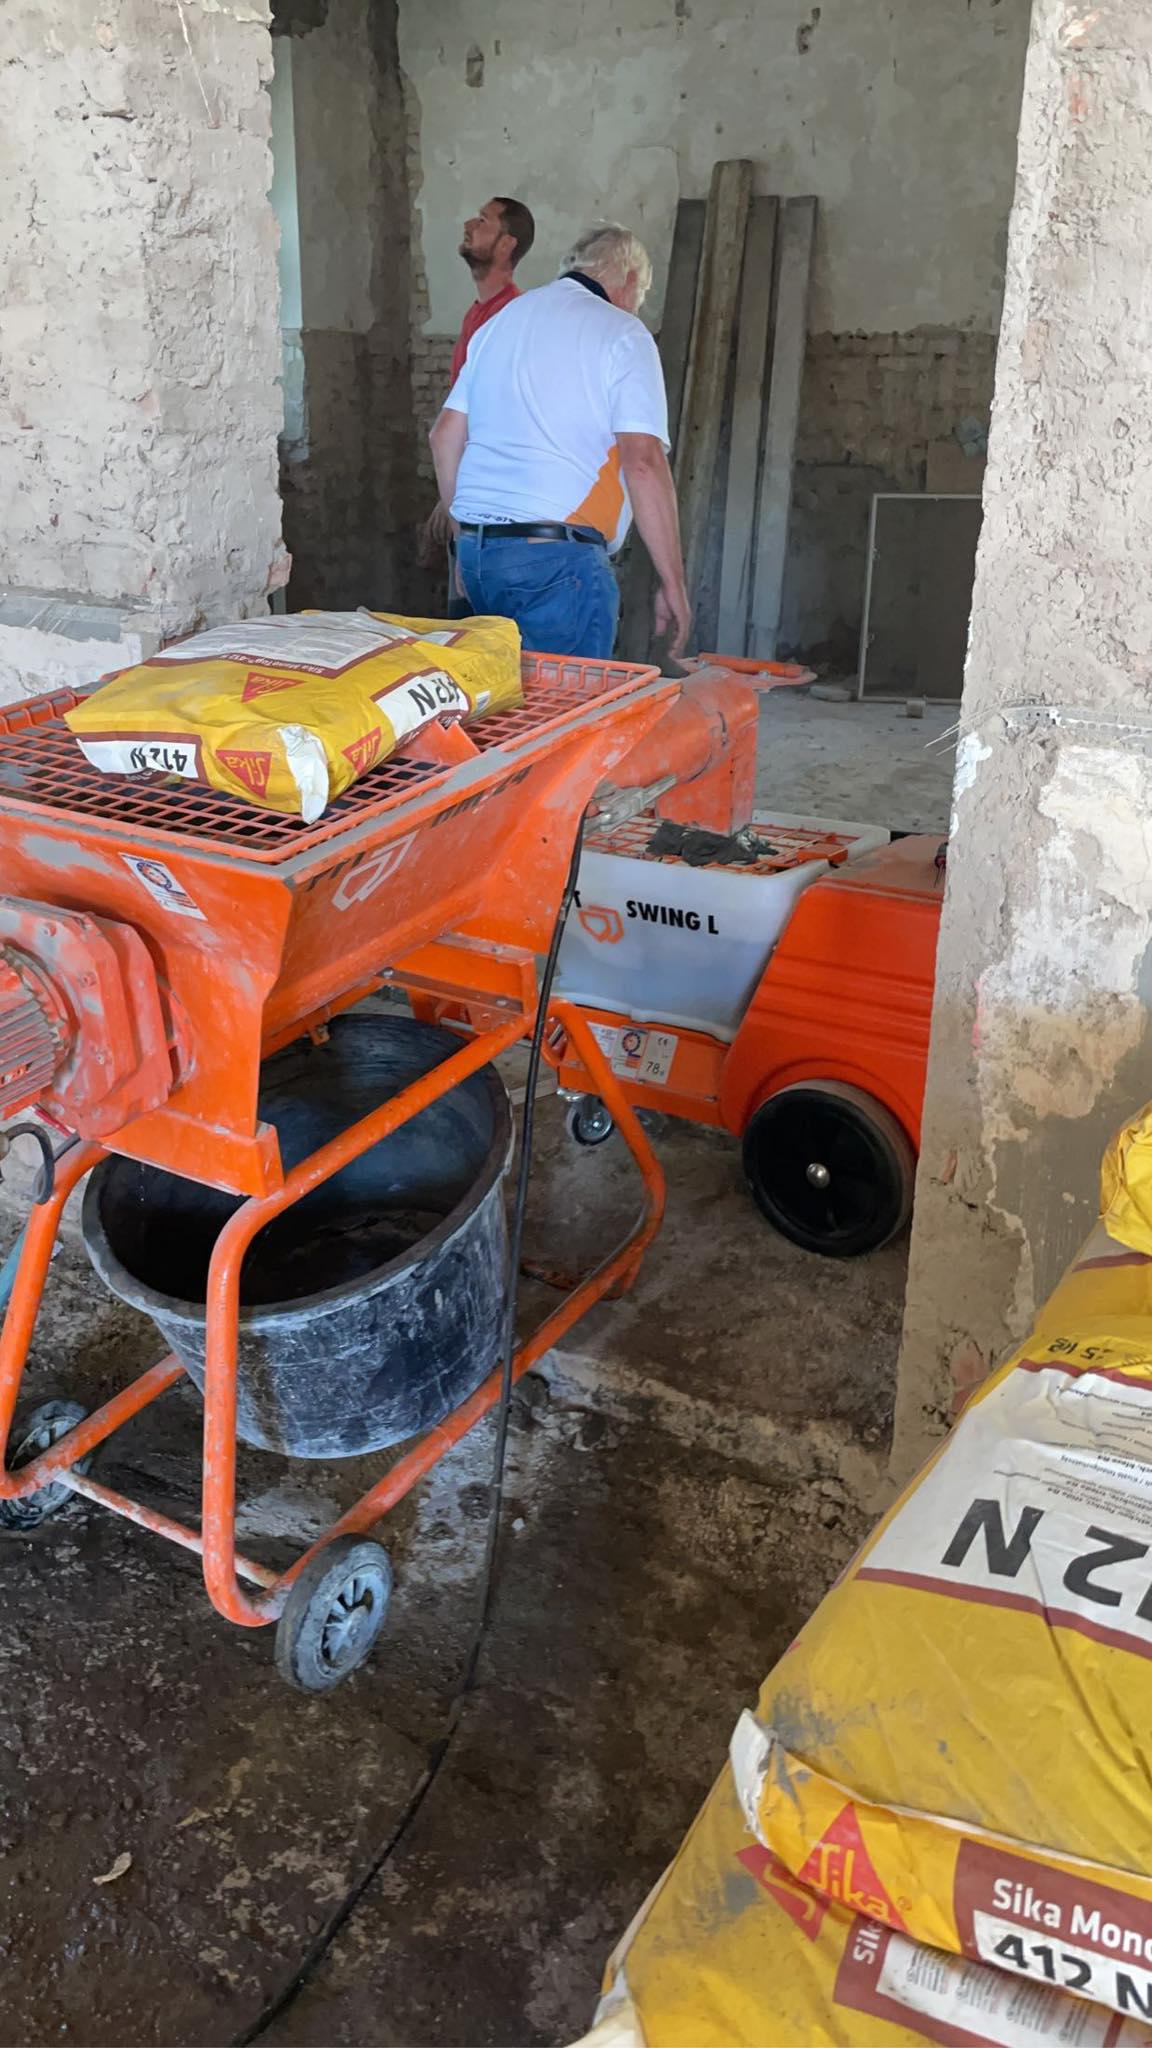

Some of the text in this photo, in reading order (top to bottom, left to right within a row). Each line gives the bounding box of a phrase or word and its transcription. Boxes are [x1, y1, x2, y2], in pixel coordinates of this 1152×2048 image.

[407, 682, 437, 717] N
[130, 747, 188, 772] 412 N
[225, 756, 266, 786] Sika
[626, 900, 719, 935] SWING L
[646, 1061, 660, 1074] 78
[940, 1498, 1152, 1622] 2 N
[808, 1841, 892, 1923] Sika
[992, 1878, 1061, 1928] Sika
[853, 1918, 884, 1965] Sik
[993, 1934, 1094, 1995] 412
[1116, 1971, 1152, 2019] N
